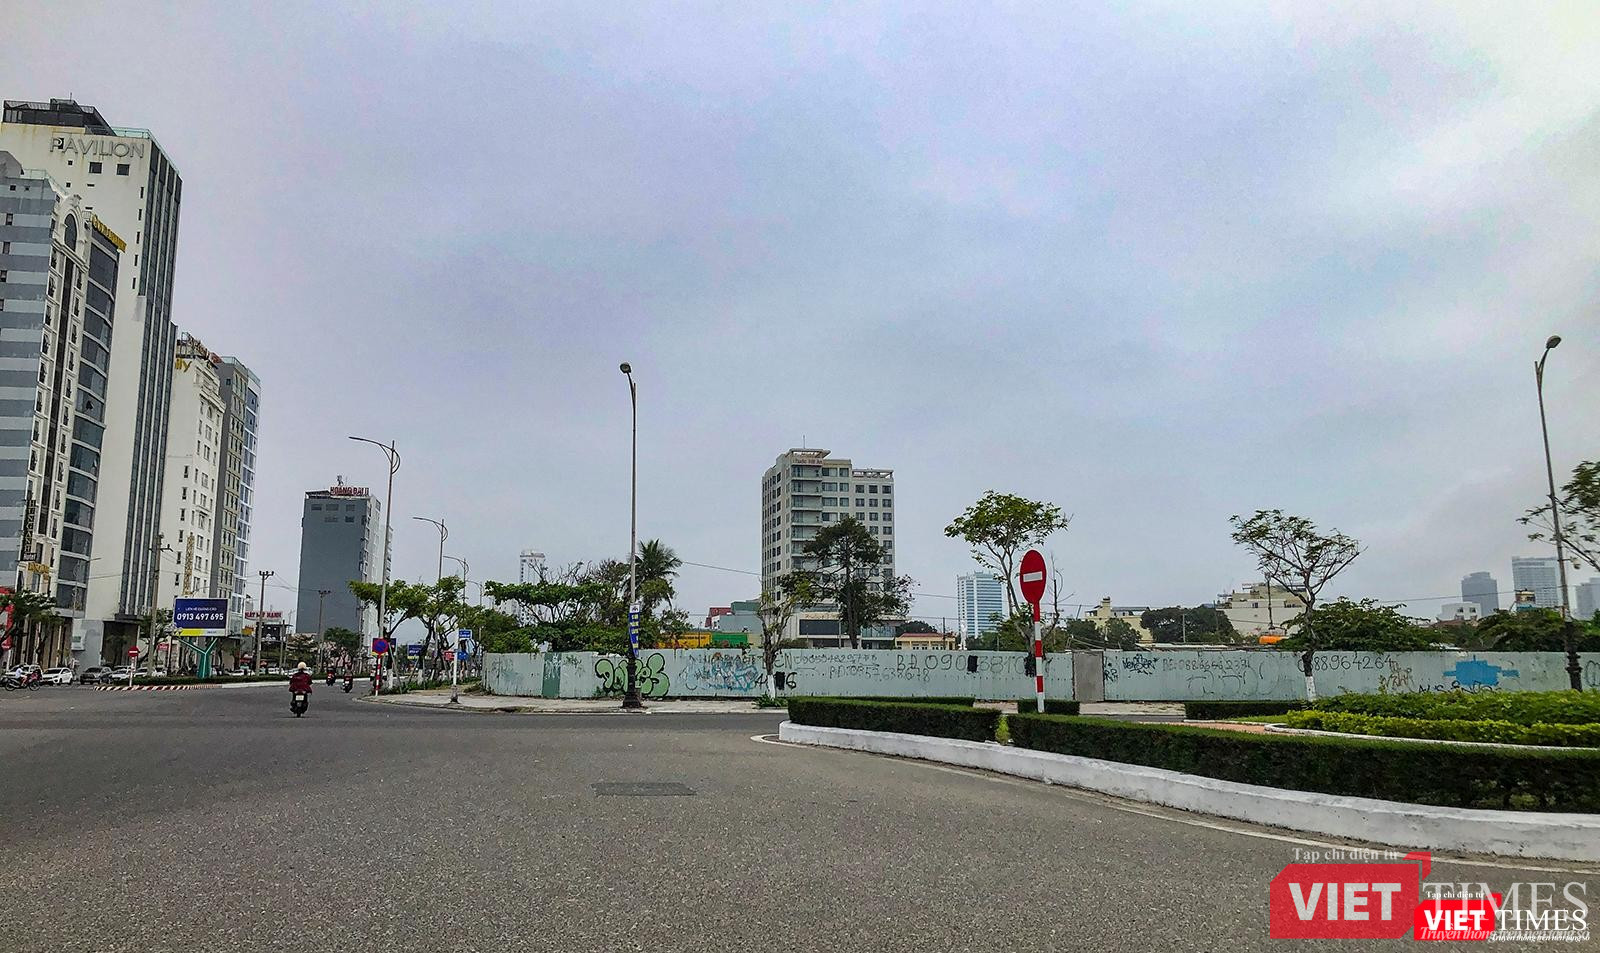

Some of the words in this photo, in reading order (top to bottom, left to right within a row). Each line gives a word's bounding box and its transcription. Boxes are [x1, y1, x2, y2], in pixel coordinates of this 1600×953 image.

[50, 137, 145, 159] PAVILION
[177, 613, 194, 621] 0913
[195, 613, 209, 621] 497
[210, 613, 224, 621] 695
